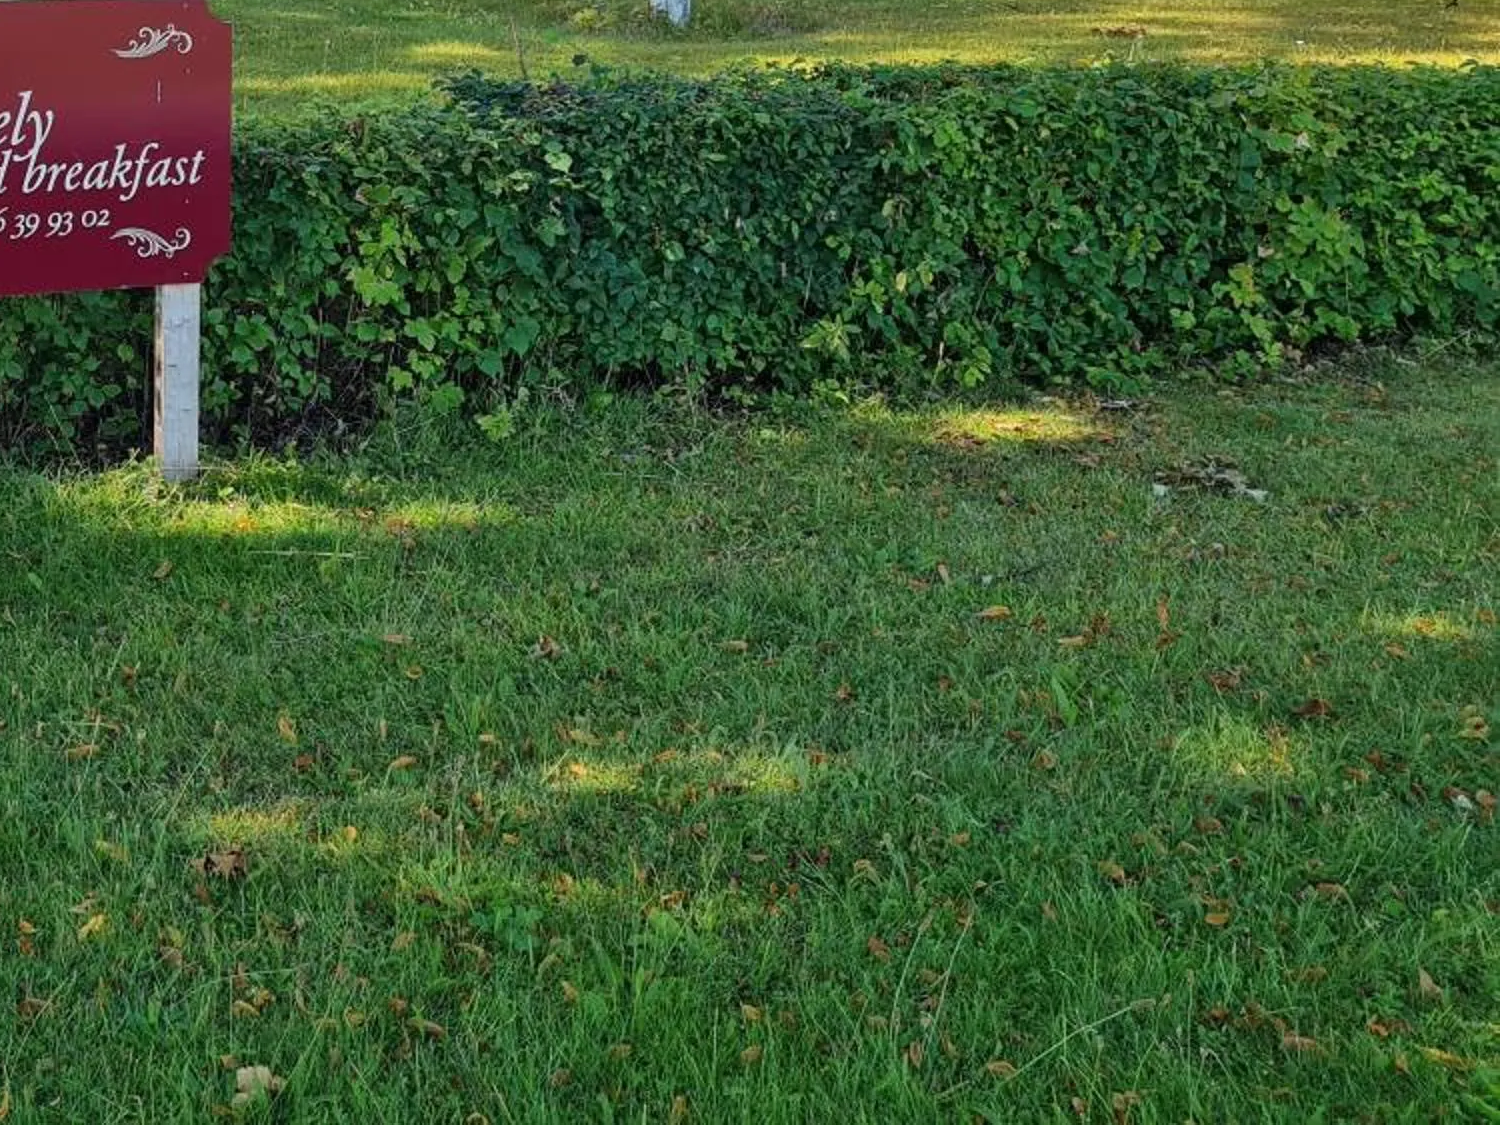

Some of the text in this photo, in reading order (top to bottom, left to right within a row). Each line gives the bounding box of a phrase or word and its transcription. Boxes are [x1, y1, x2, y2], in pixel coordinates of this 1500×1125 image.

[22, 142, 206, 202] breakfast
[10, 213, 41, 239] 39
[45, 211, 74, 237] 93
[81, 209, 111, 228] 02
